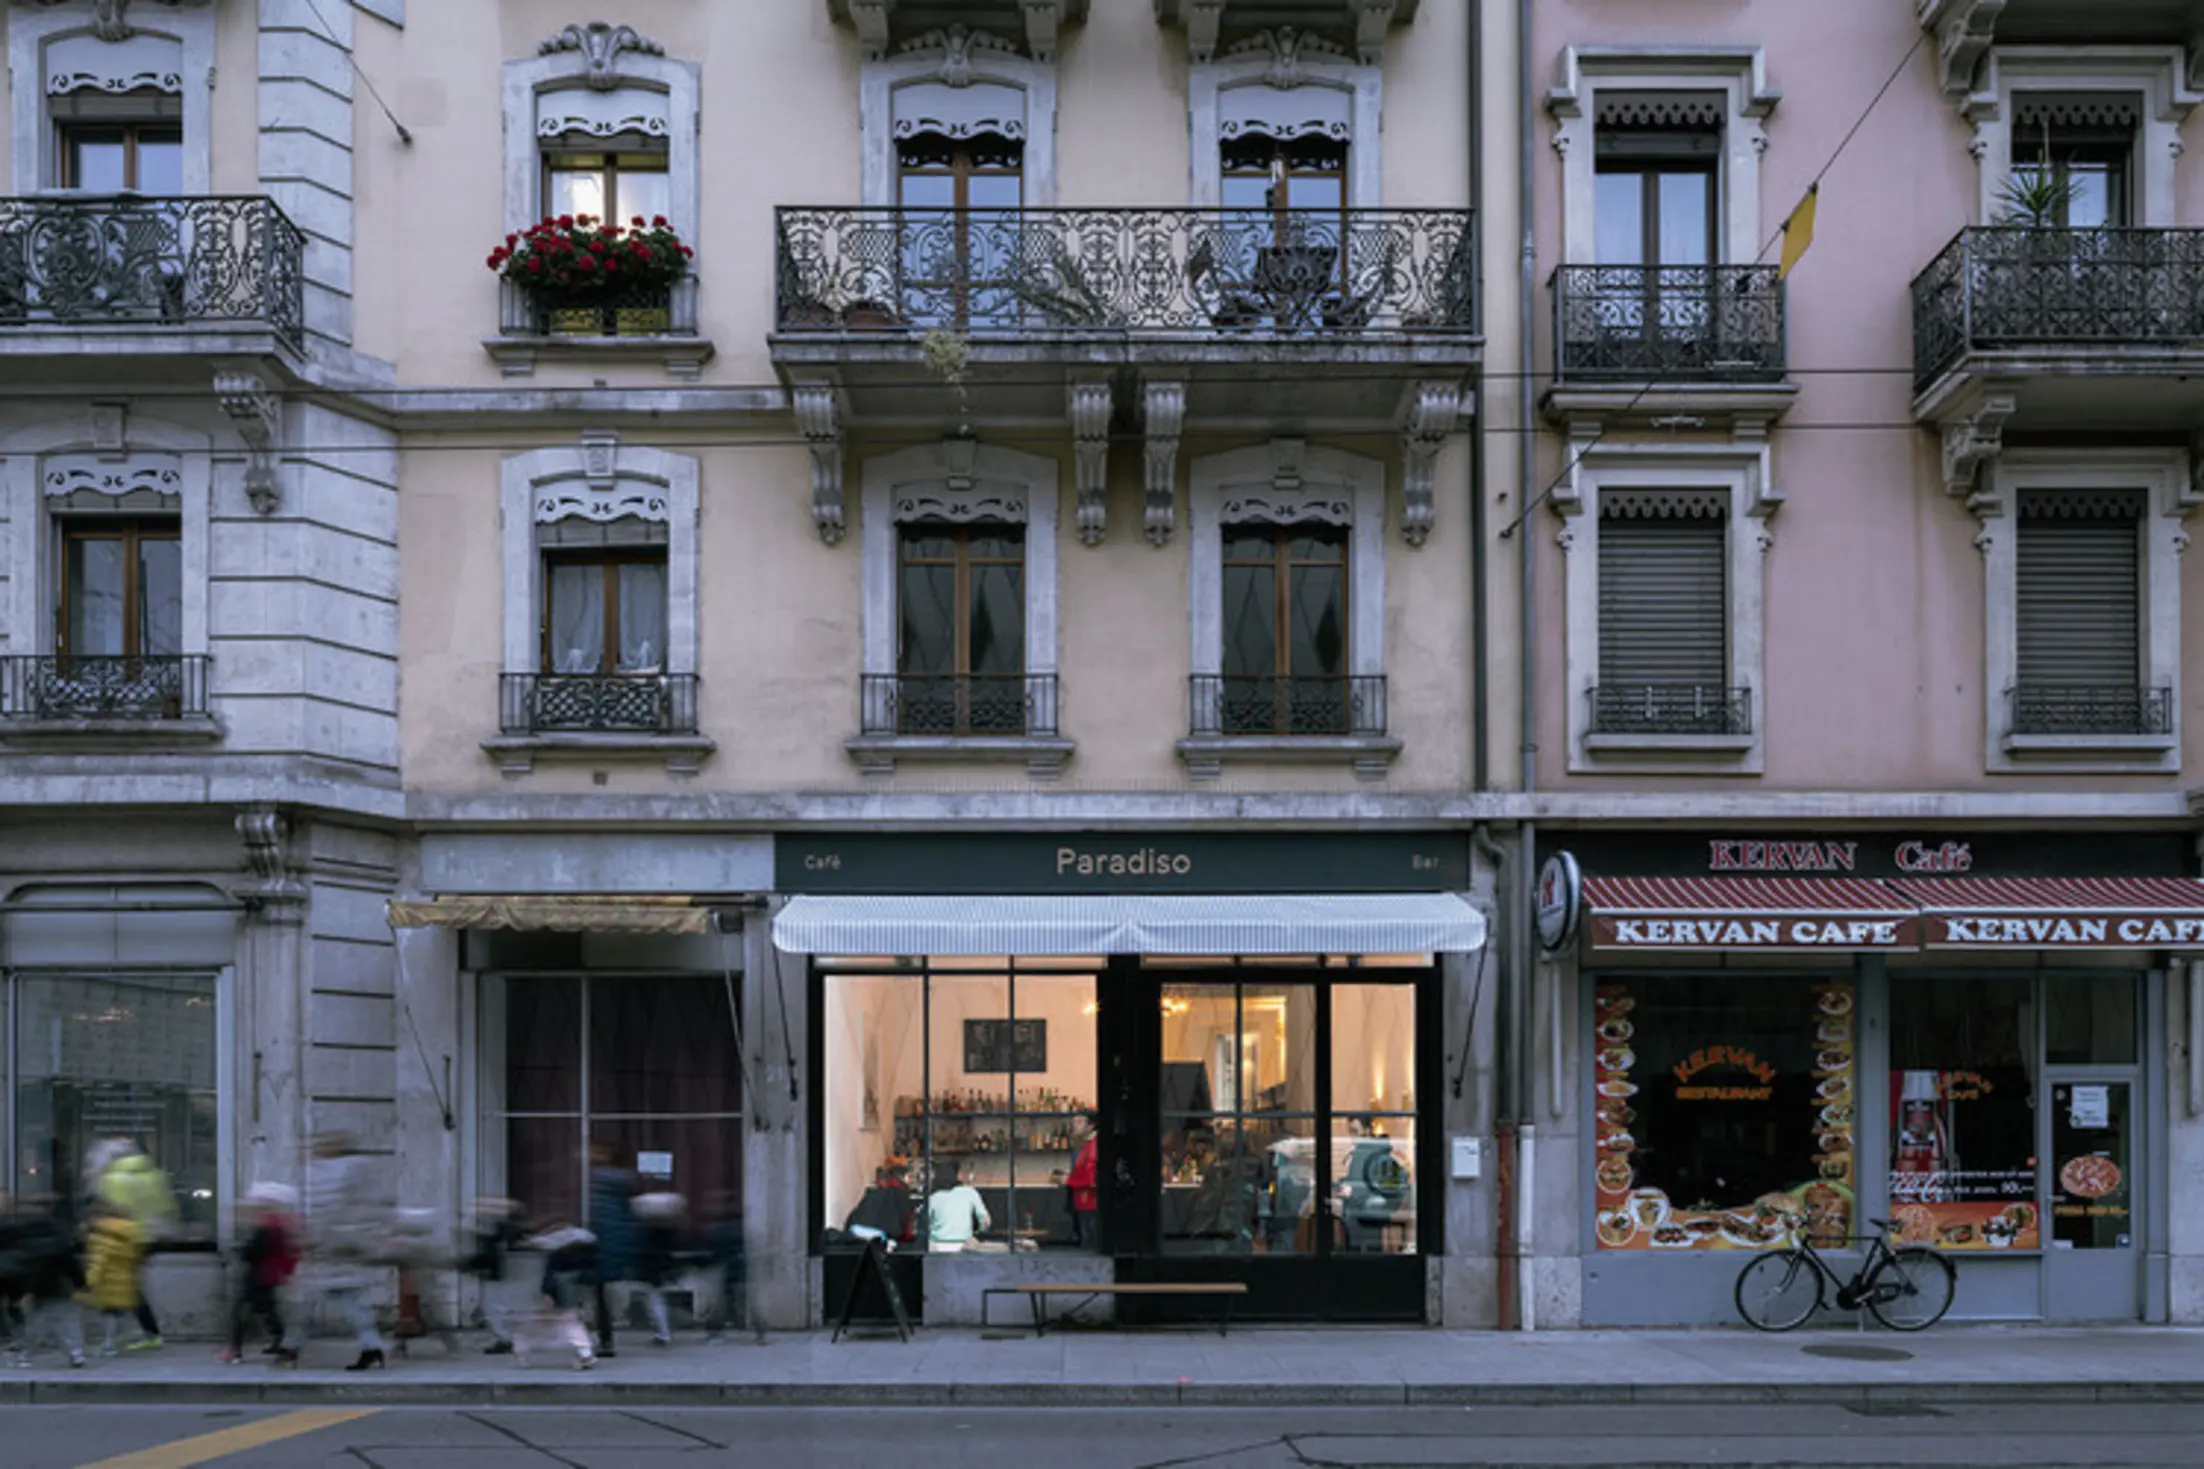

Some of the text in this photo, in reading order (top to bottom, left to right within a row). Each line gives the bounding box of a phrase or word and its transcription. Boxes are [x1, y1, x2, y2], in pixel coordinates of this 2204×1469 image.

[1056, 847, 1192, 875] Paradiso
[1411, 853, 1441, 870] Bar
[1709, 840, 1973, 871] KERVAN Café
[1615, 920, 1898, 943] KERVAN CAFE
[1945, 918, 2204, 941] KERVAN CAF
[1673, 1044, 1776, 1083] KERVAN
